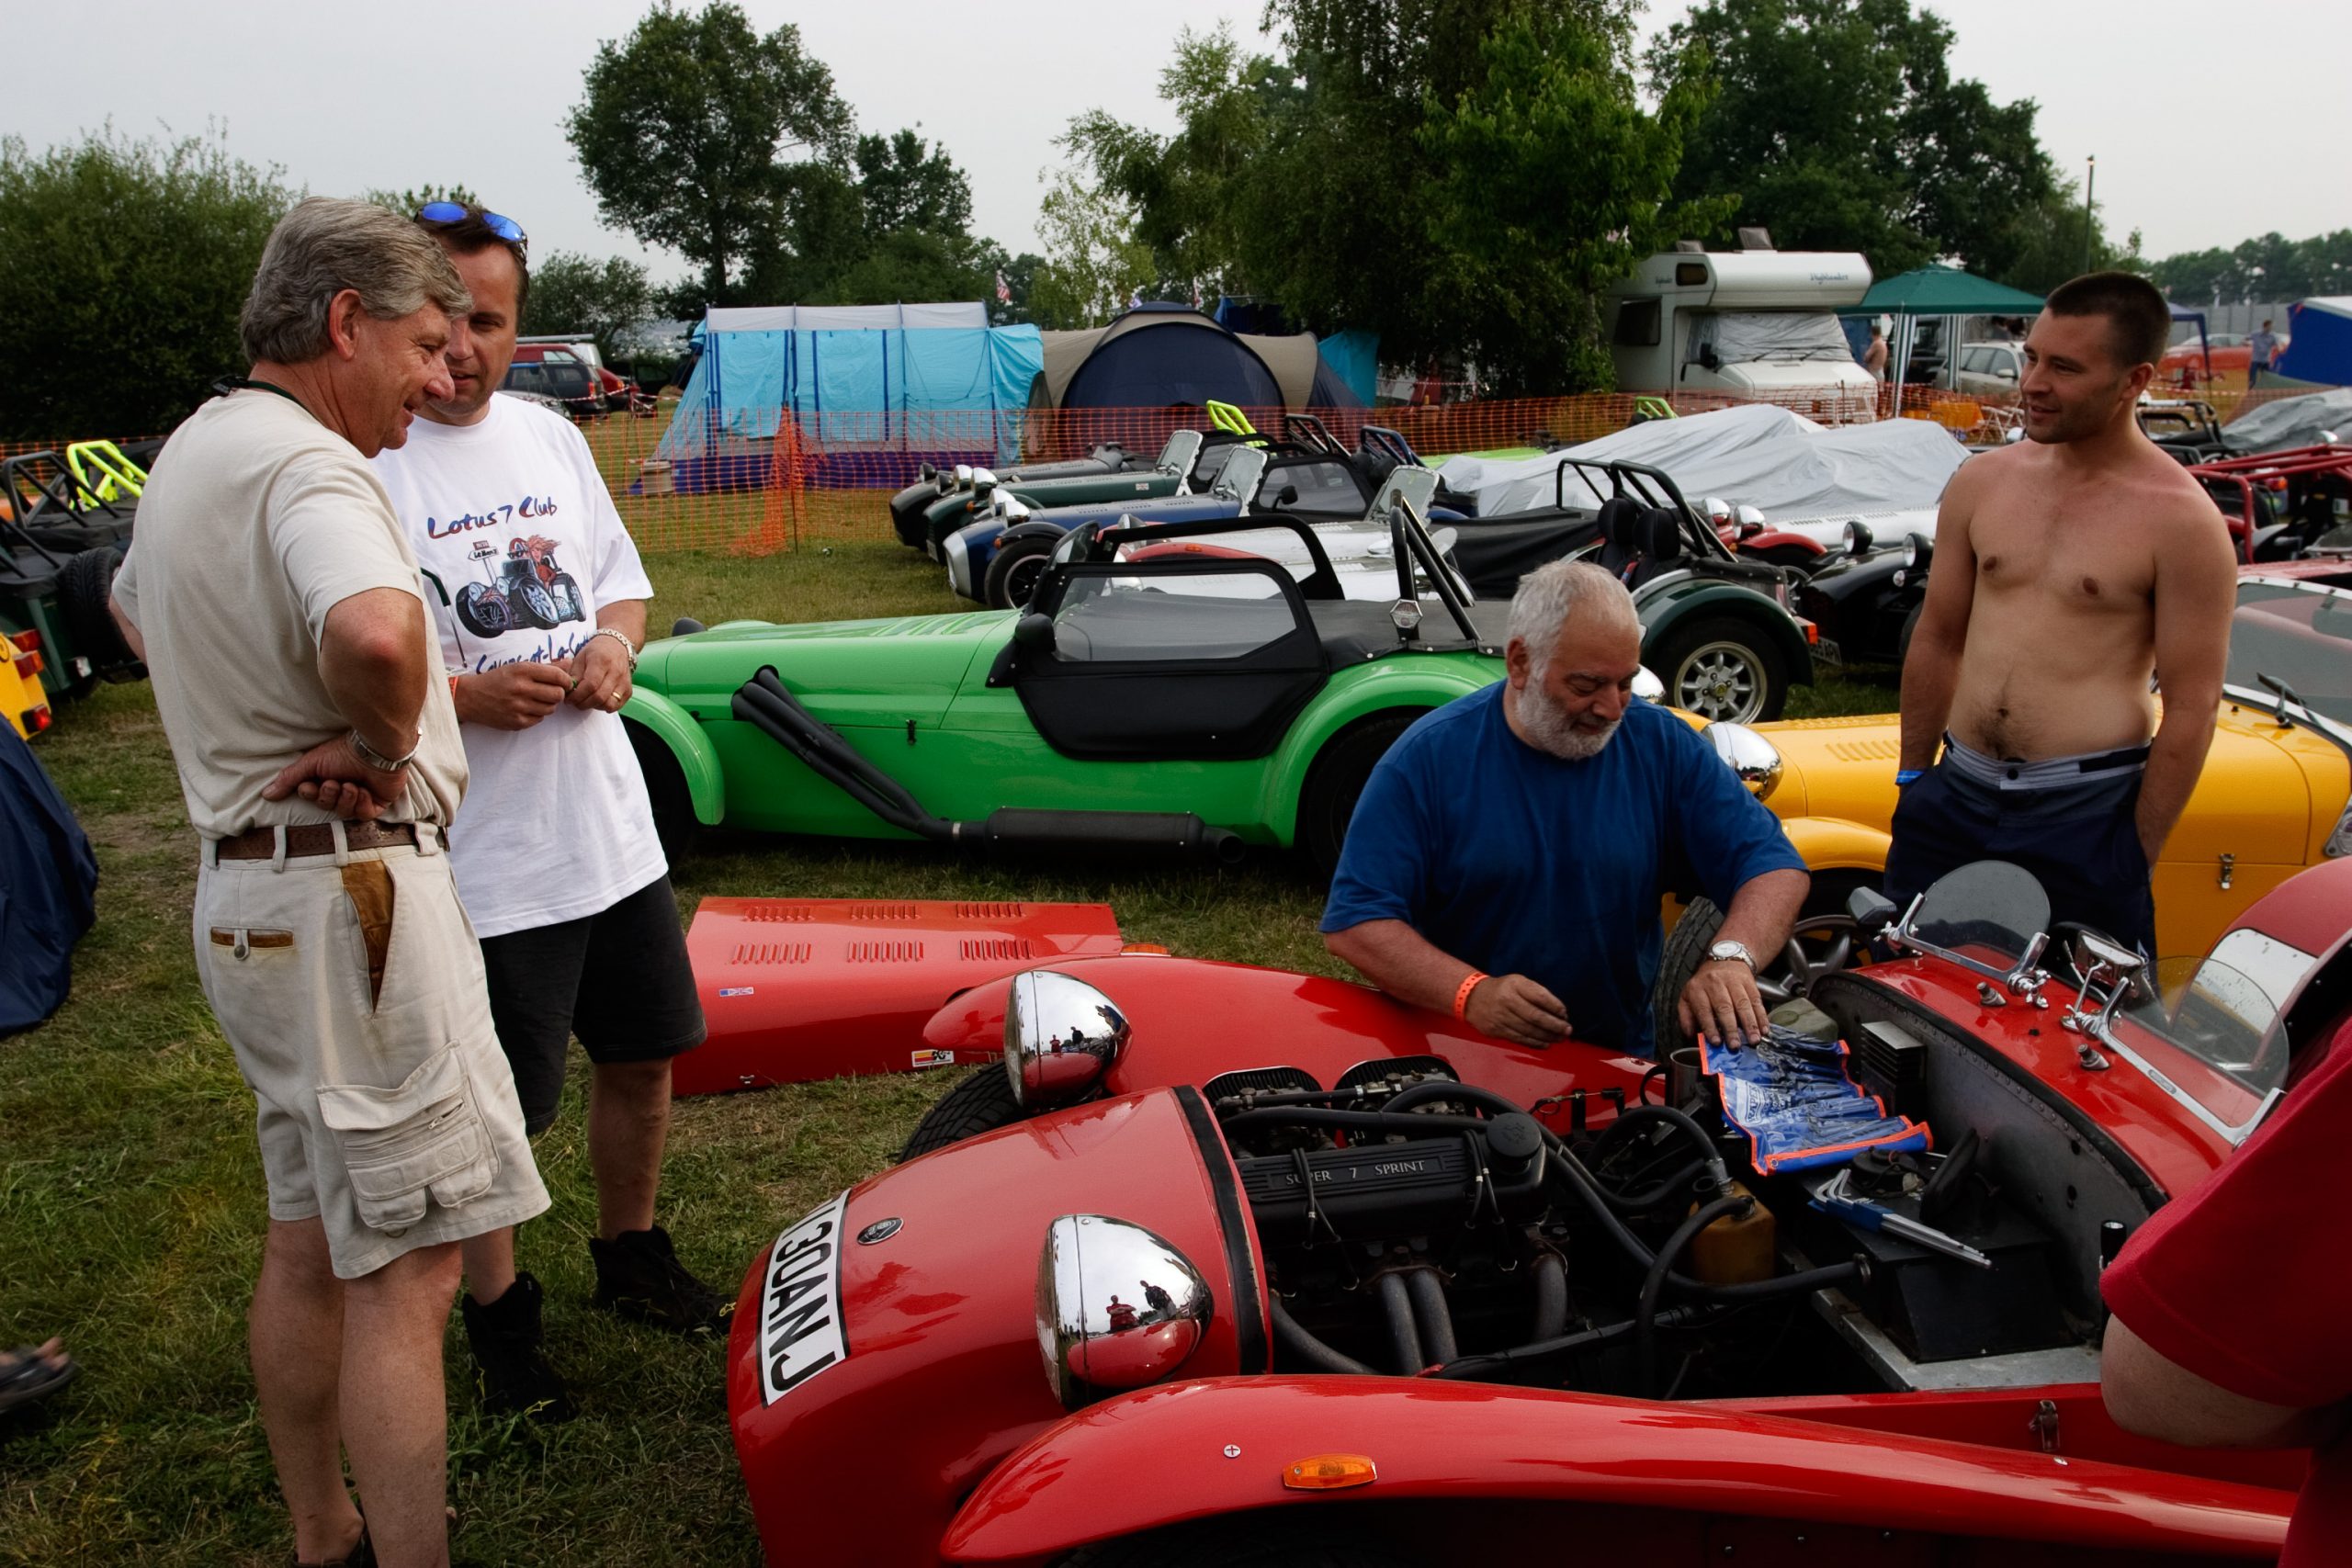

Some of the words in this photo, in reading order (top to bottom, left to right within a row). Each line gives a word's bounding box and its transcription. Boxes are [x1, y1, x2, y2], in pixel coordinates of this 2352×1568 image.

[427, 512, 497, 539] Lotus
[498, 504, 513, 524] 7
[519, 496, 558, 518] Club
[1349, 1168, 1357, 1179] 7
[1374, 1160, 1425, 1176] SPRINT
